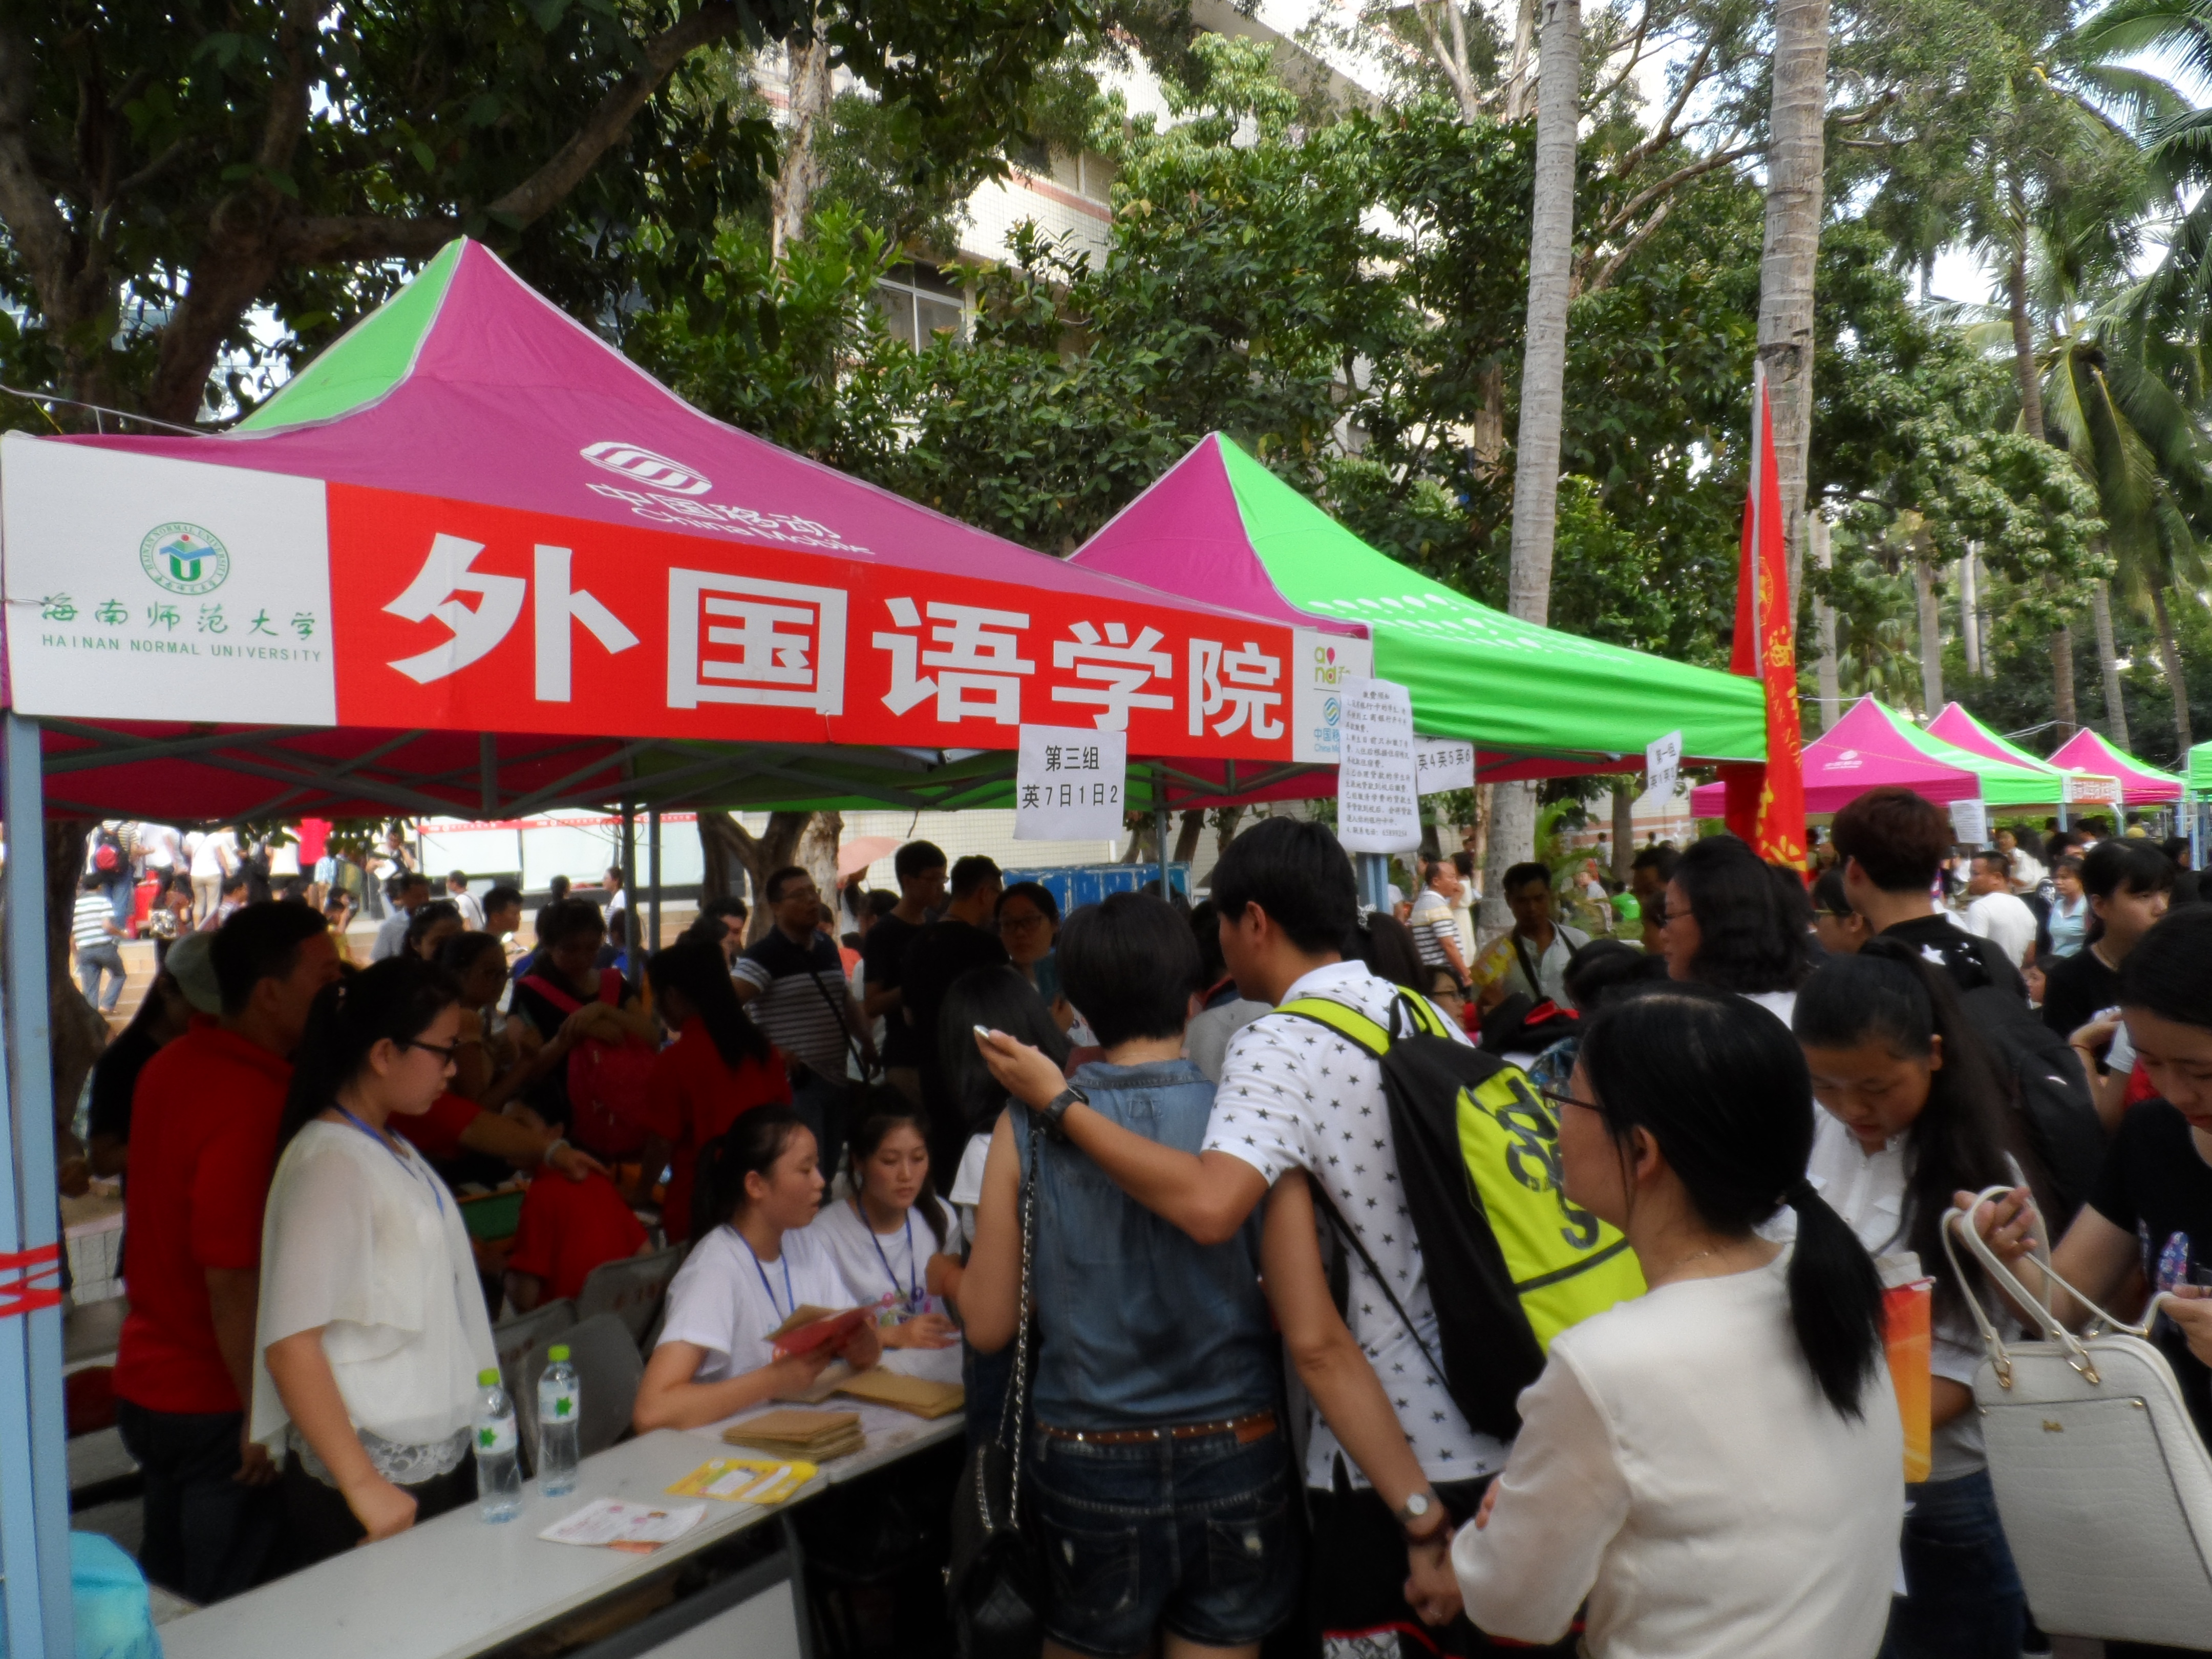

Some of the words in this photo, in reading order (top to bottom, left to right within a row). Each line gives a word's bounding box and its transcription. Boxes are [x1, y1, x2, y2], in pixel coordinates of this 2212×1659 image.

[585, 482, 841, 540] 中国移动
[41, 592, 316, 640] 海南师范大学
[42, 634, 119, 650] HAINAN
[131, 639, 200, 656] NORMAL
[211, 645, 322, 663] UNIVERSITY
[380, 532, 1284, 739] 外国语学院
[1045, 745, 1099, 772] 第三组
[1417, 748, 1471, 771] 英4英5英6
[1022, 783, 1119, 810] 英7日1日2
